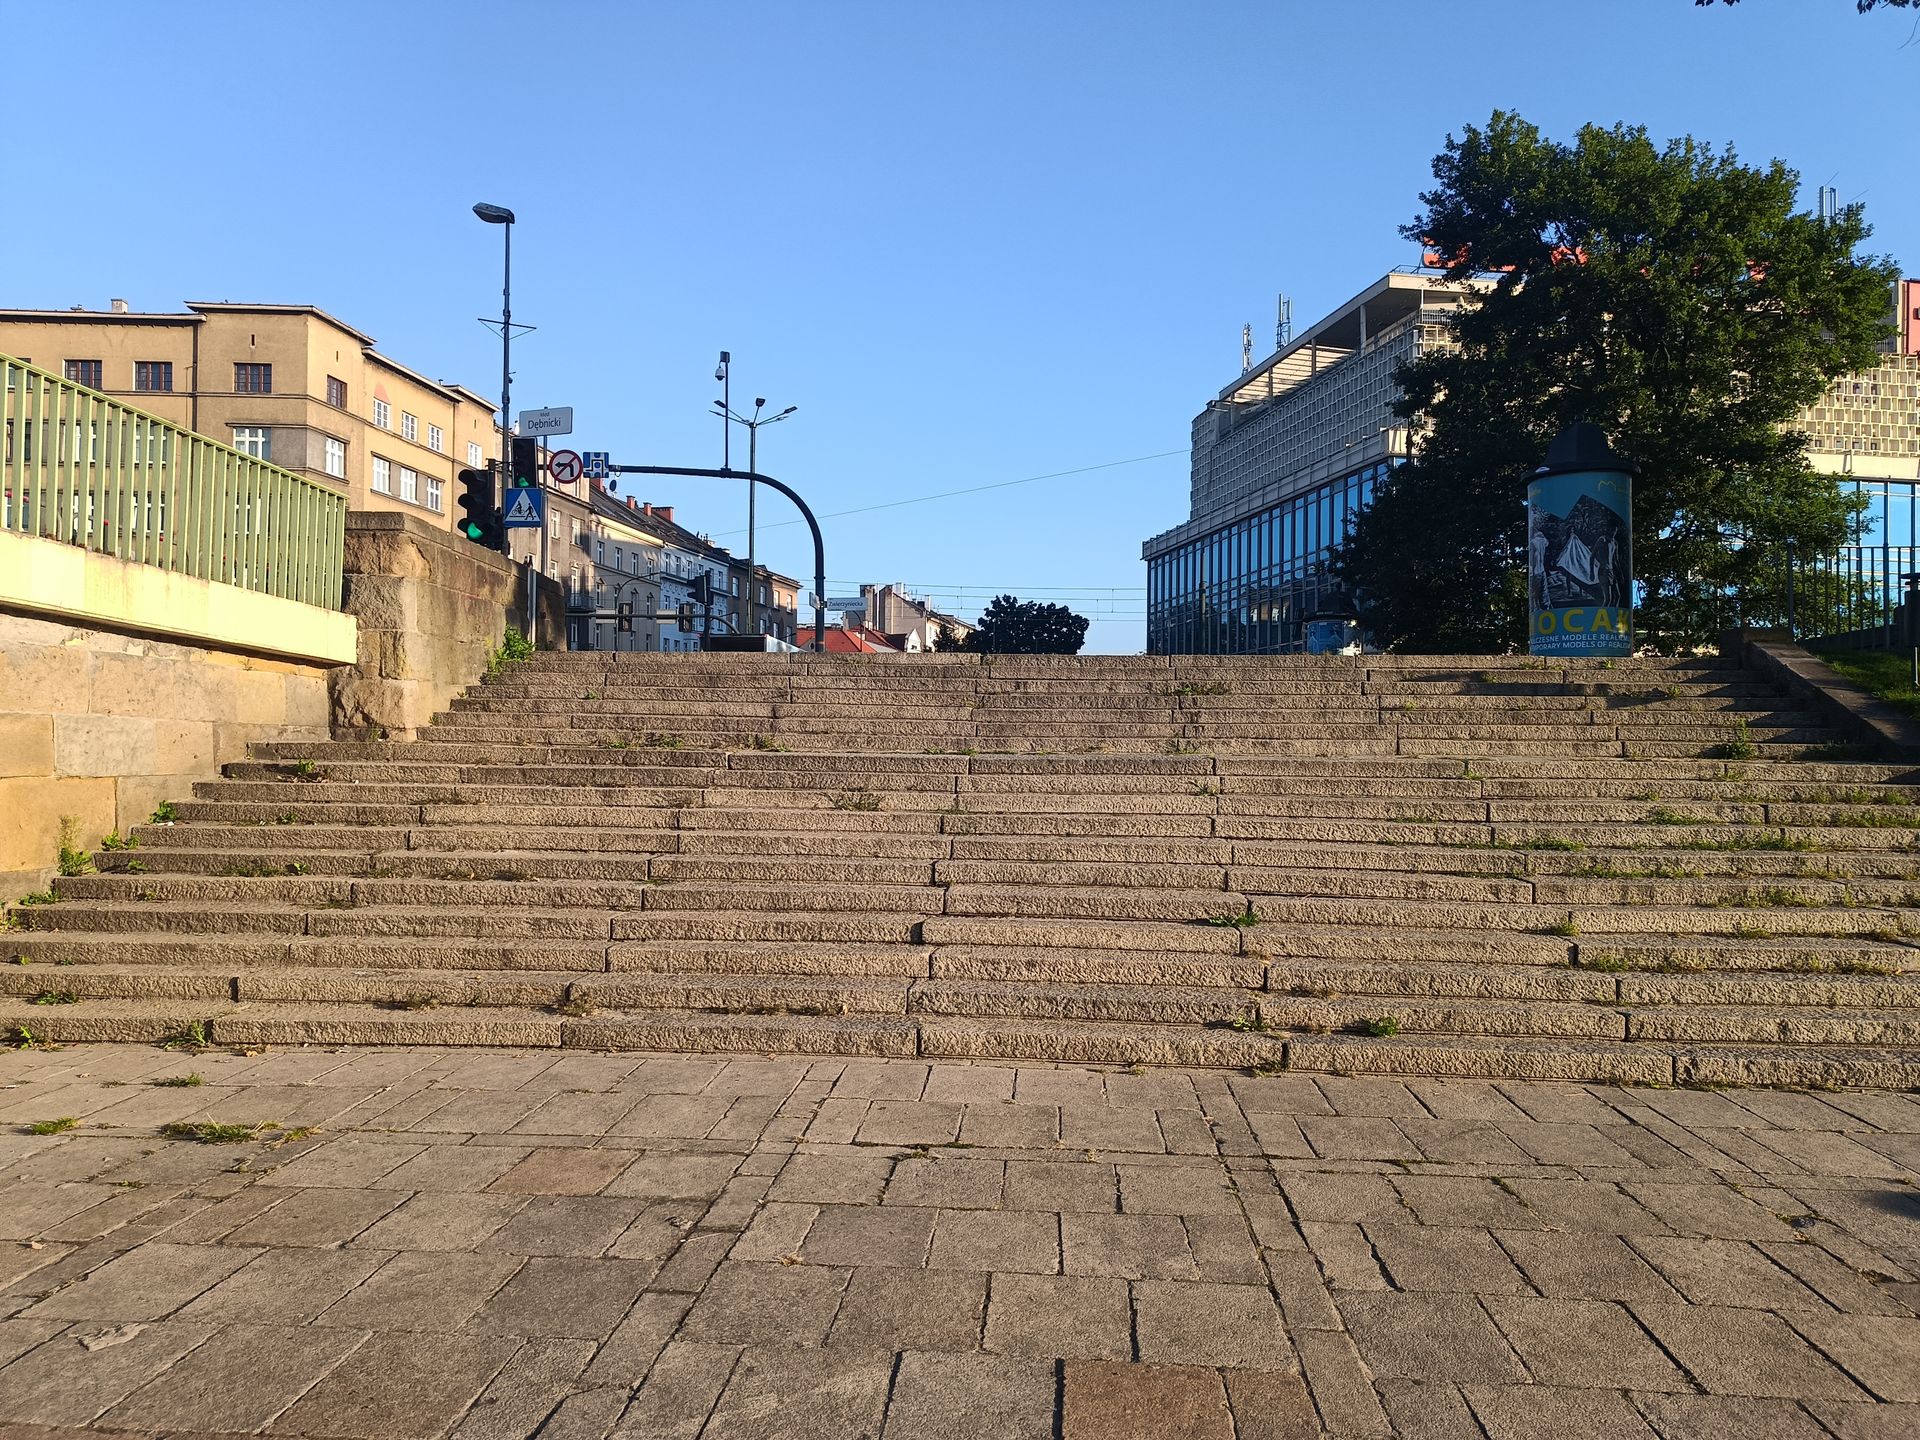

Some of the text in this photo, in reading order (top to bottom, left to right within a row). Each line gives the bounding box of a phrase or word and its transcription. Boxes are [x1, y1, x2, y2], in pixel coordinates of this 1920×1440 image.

[528, 417, 561, 431] Dębnicki
[1561, 633, 1597, 641] MODELE
[1562, 640, 1596, 649] MODELS
[1597, 640, 1607, 648] OF
